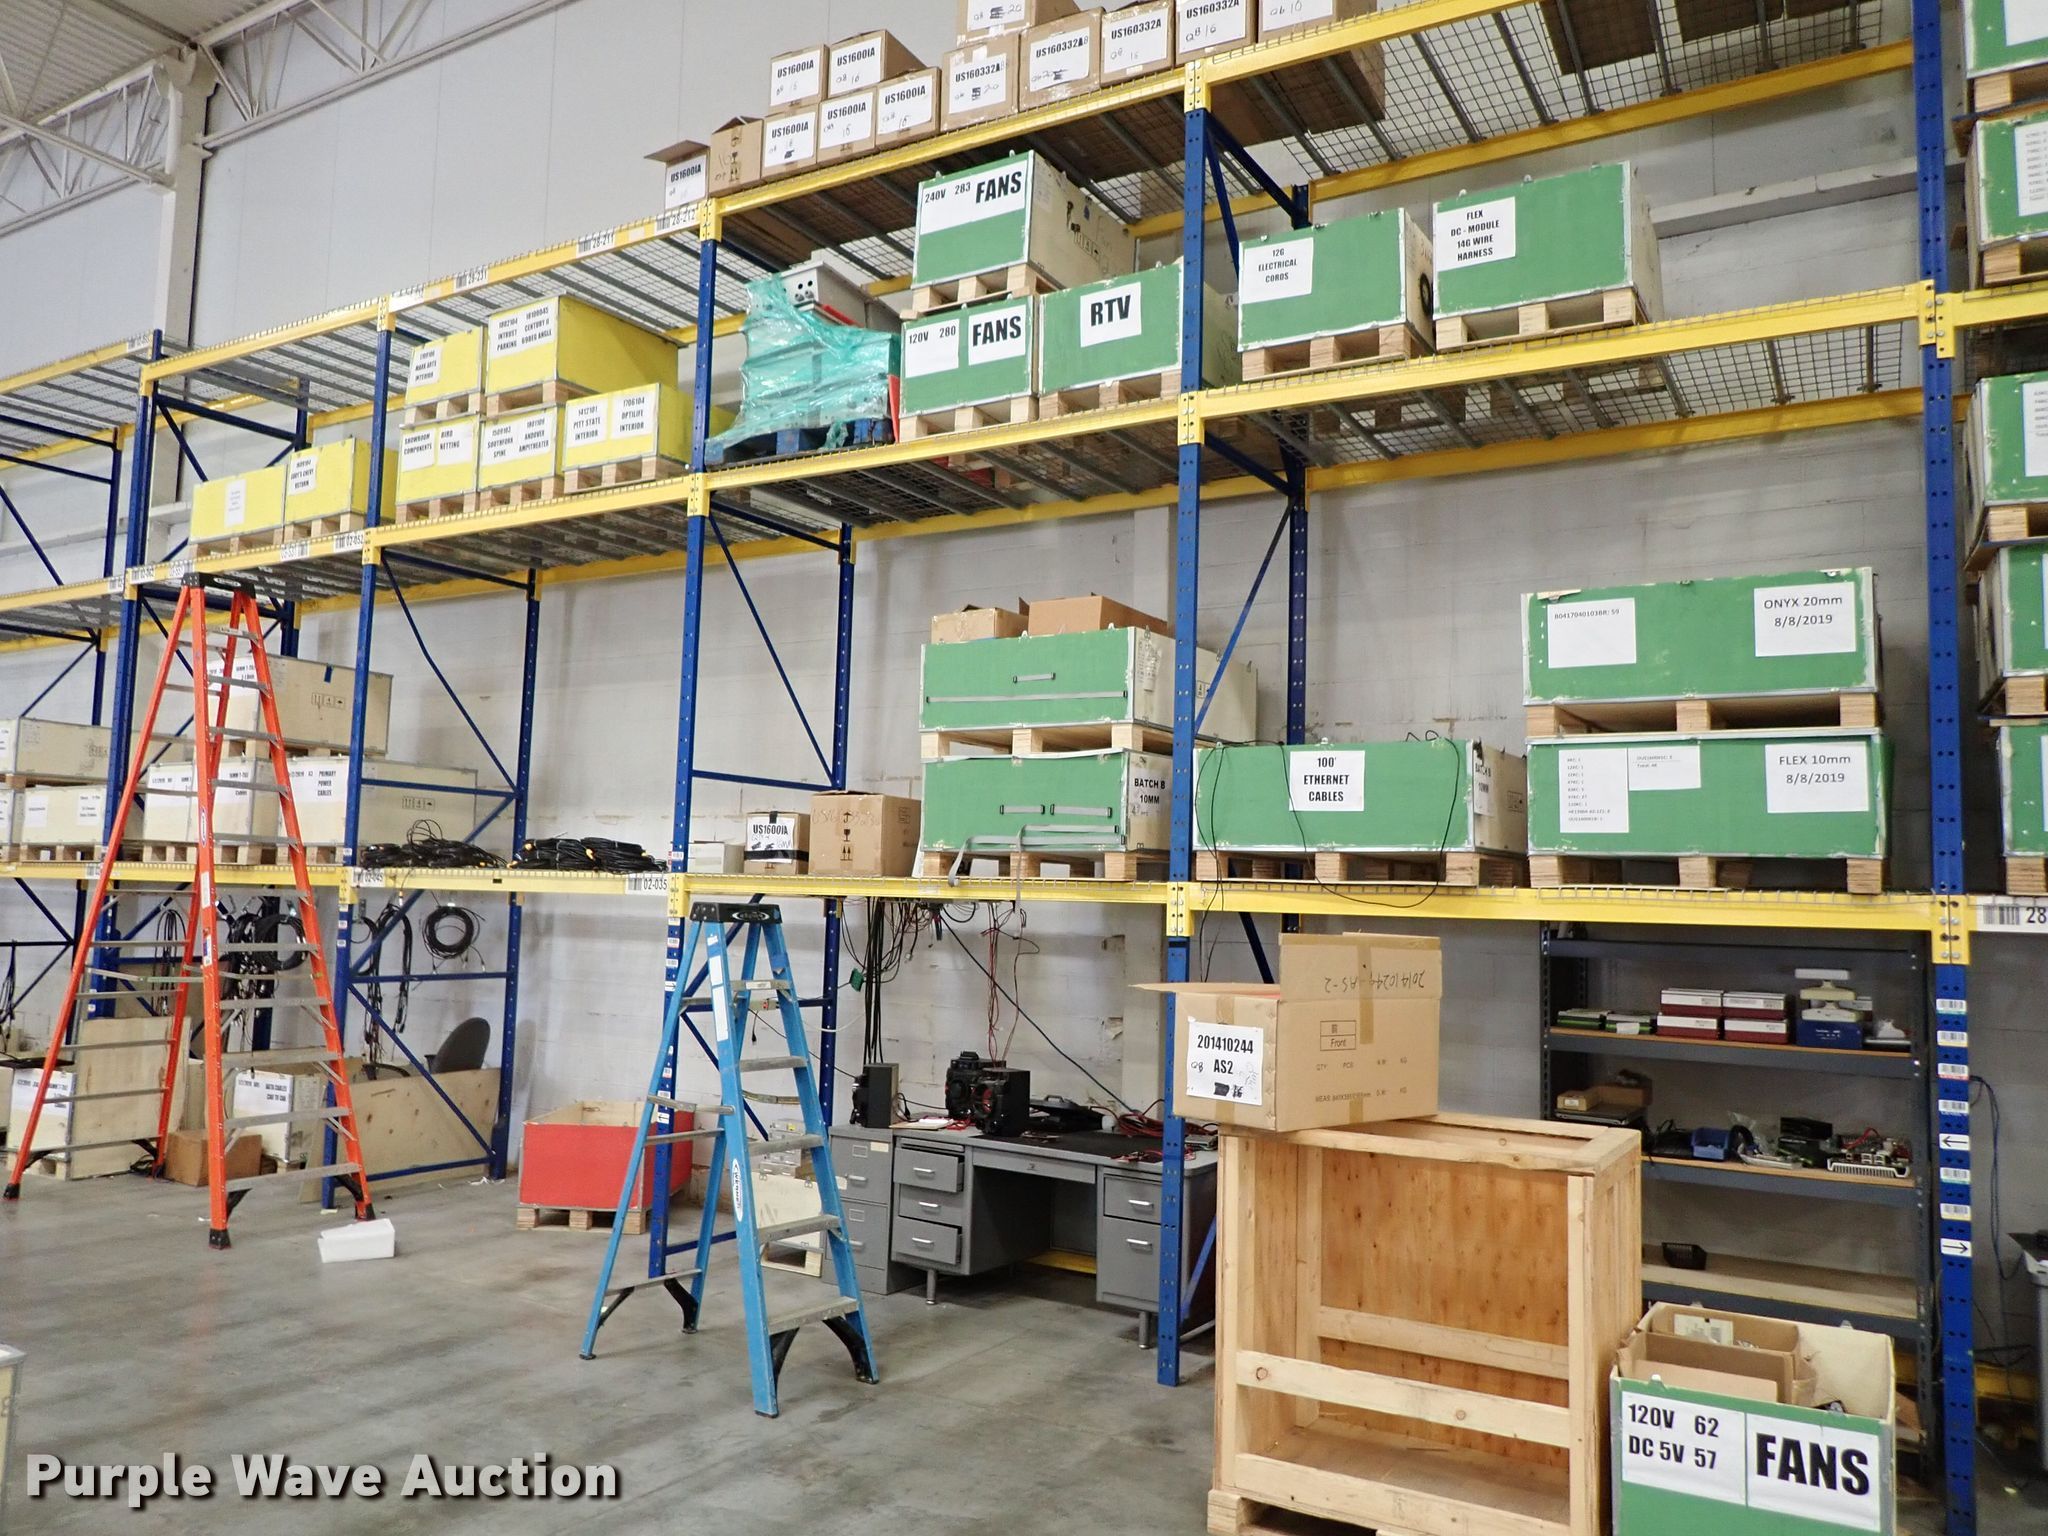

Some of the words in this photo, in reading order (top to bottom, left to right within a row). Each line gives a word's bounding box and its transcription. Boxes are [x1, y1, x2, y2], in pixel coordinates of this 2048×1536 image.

[1111, 19, 1162, 40] US160332A
[924, 189, 946, 204] 240V
[954, 181, 971, 195] 283
[975, 171, 1022, 204] FANS
[1466, 209, 1483, 220] FLEX
[1450, 227, 1462, 237] DC
[1468, 219, 1500, 234] MODULE
[1457, 239, 1471, 249] 14G
[1472, 234, 1493, 245] WIRE
[1272, 248, 1284, 257] 12G
[1457, 247, 1493, 261] HARNESS
[1258, 258, 1297, 272] ELECTRICAL
[1265, 272, 1289, 283] CORDS
[1090, 294, 1131, 327] RTV
[908, 331, 929, 345] 120V
[939, 325, 956, 339] 280
[972, 315, 1022, 347] FANS
[620, 421, 644, 432] INTERIOR
[575, 429, 598, 441] INTERIOR
[1763, 598, 1799, 609] ONYX
[1803, 596, 1843, 607] 20mm
[1774, 614, 1833, 628] 8/8/2019
[1779, 755, 1808, 765] FLEX
[1812, 754, 1851, 765] 10mm
[1134, 777, 1159, 789] BATCH
[1303, 774, 1350, 785] ETHERNET
[1786, 773, 1845, 785] 8/8/2019
[1139, 794, 1160, 805] 10MM
[1308, 791, 1344, 802] CABLES
[643, 878, 668, 890] 02-035
[1197, 1034, 1254, 1054] 201410244
[1330, 1038, 1347, 1048] Front
[1213, 1058, 1234, 1075] AS2
[1628, 1403, 1675, 1429] 120V
[1694, 1415, 1720, 1438] 62
[1629, 1435, 1654, 1457] DC
[1659, 1441, 1684, 1464] 5V
[1694, 1448, 1717, 1470] 57
[1756, 1432, 1870, 1496] FANS
